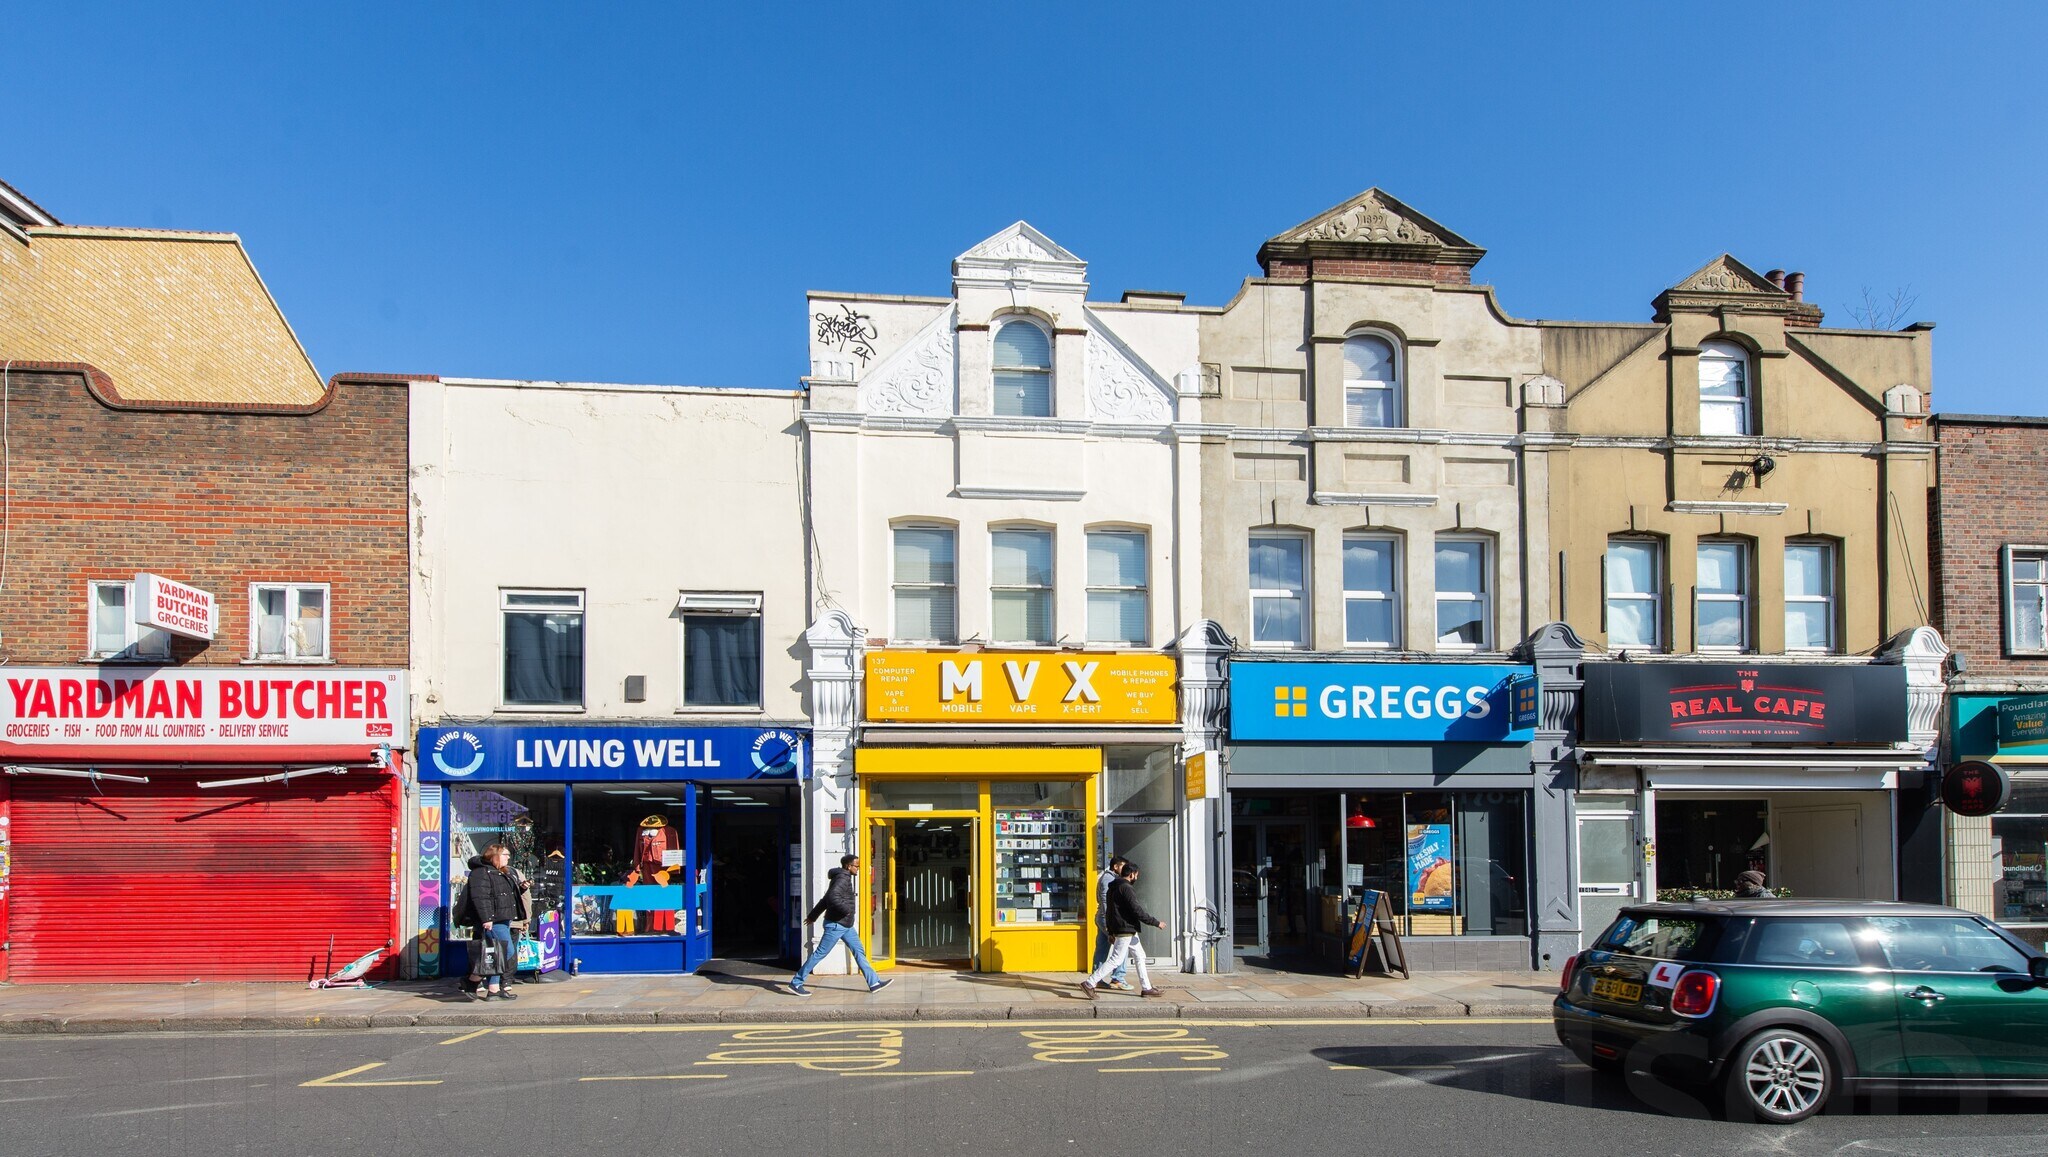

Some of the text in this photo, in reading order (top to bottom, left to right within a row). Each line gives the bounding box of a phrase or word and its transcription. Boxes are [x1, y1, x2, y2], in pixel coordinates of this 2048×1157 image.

[158, 581, 208, 607] YARDMAN
[157, 595, 208, 622] BUTCHER
[157, 611, 208, 634] GROCERIES
[873, 667, 916, 675] COMPUTER
[1110, 669, 1138, 677] MOBILE
[941, 660, 1101, 701] M V X
[7, 679, 388, 719] YARDMAN BUTCHER
[1319, 685, 1491, 719] GREGGS
[879, 705, 910, 713] E-JUICE
[941, 704, 983, 713] MOBILE
[1009, 704, 1037, 713] VAPE
[1063, 705, 1102, 713] X-PERT
[1670, 696, 1825, 719] REAL CAFE
[1518, 712, 1537, 722] GREGGS
[2013, 712, 2046, 721] Amazing
[2016, 720, 2044, 729] Value
[6, 723, 289, 738] GROCERIES FISH FOOD FROM ALL COUNTRIES DELIVERY SERVICE
[434, 731, 482, 751] LIVING WELL
[752, 730, 776, 751] LIVING
[516, 739, 721, 768] LIVING WELL
[474, 812, 515, 823] PENGE
[1411, 842, 1440, 863] FRESHLY
[1414, 855, 1435, 870] MADE
[1655, 966, 1671, 983] L
